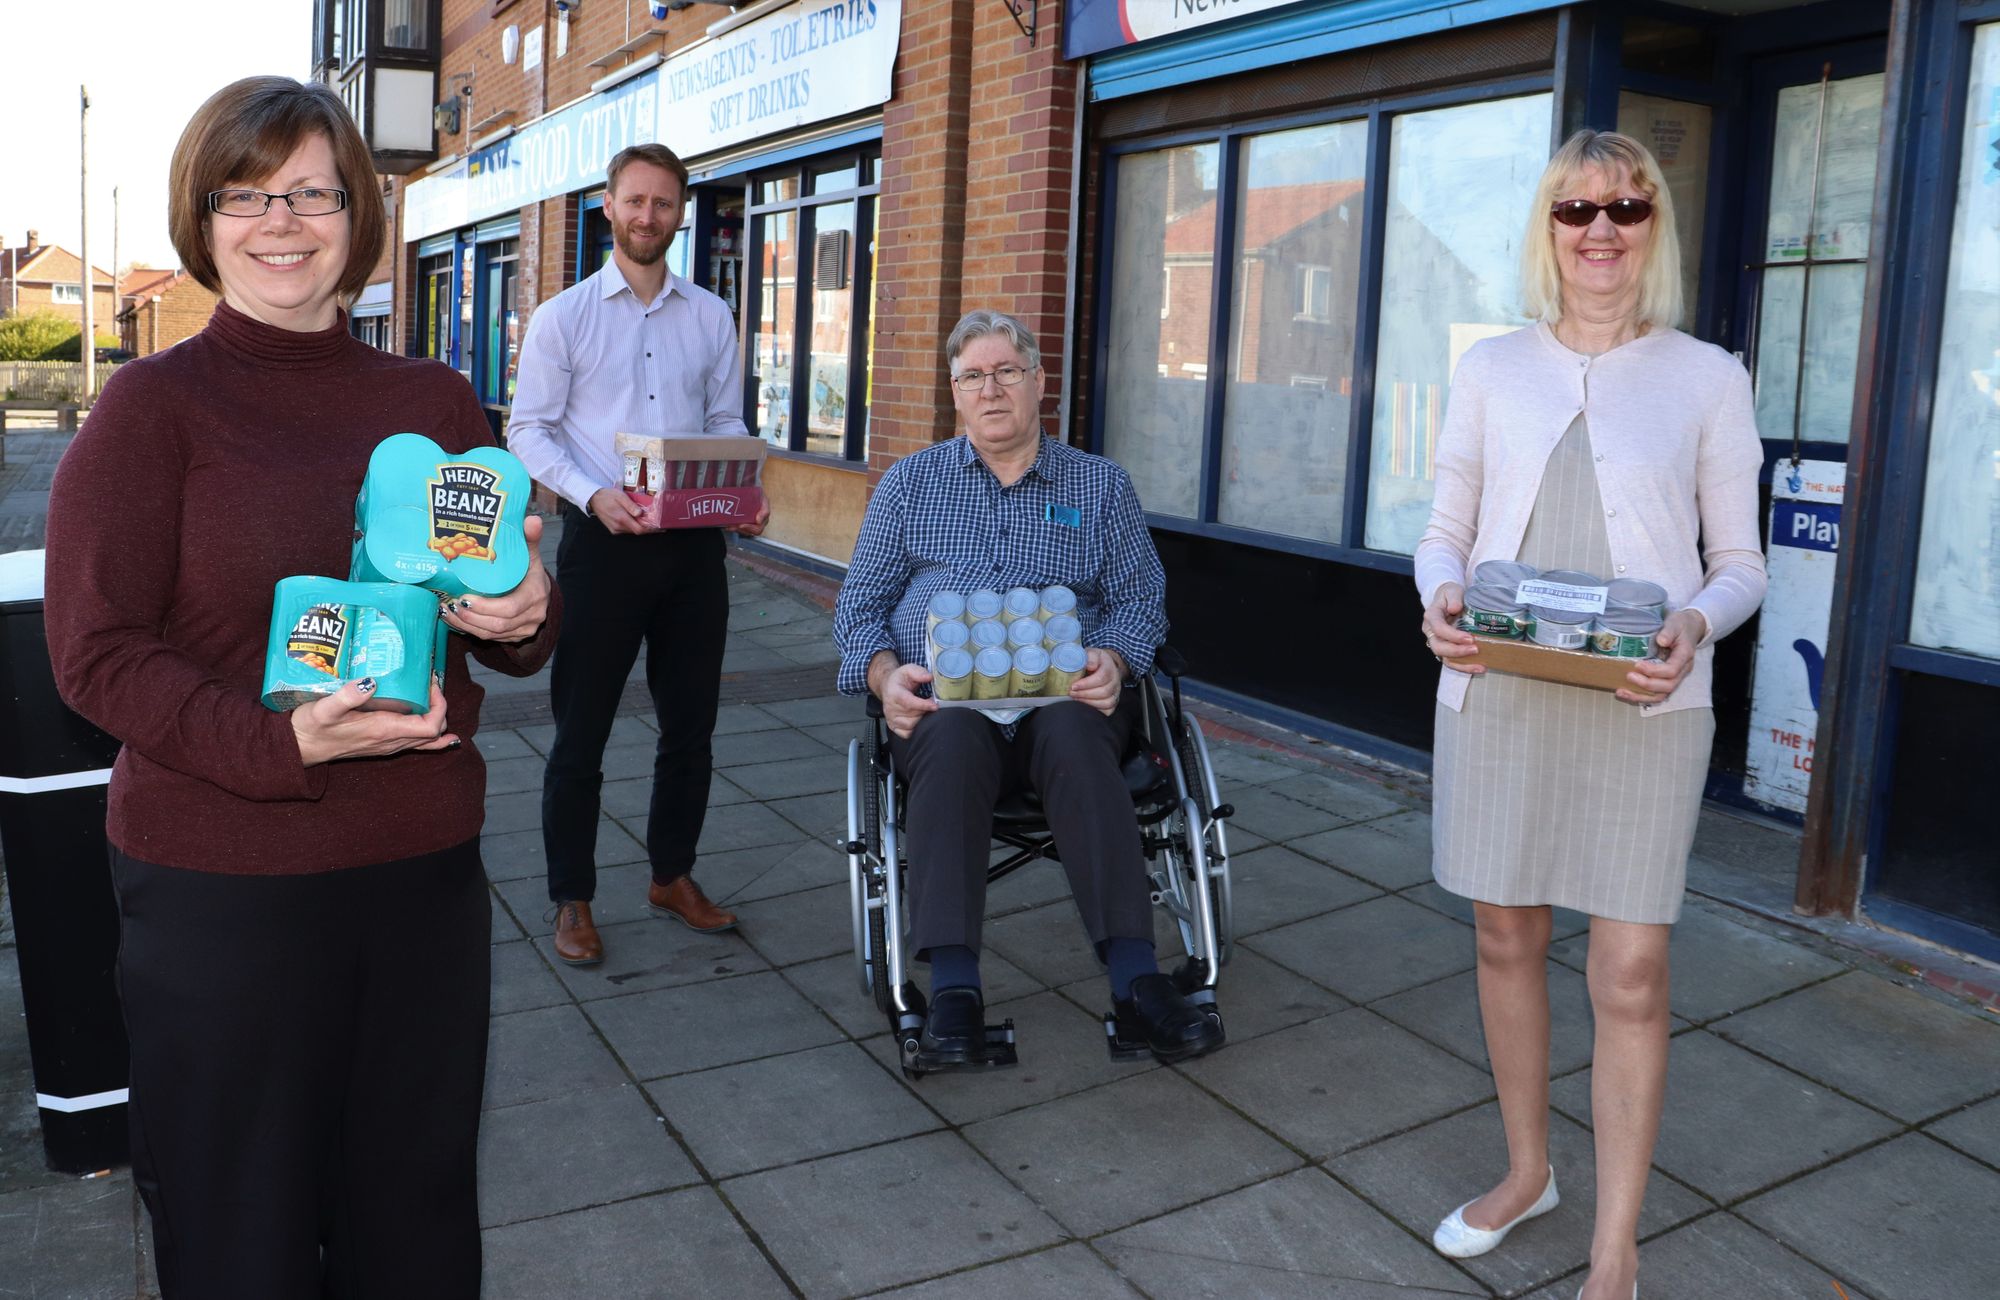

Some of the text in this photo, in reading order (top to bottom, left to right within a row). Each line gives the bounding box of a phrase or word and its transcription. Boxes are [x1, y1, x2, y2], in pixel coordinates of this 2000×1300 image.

[1174, 0, 1240, 19] Ne
[669, 38, 757, 104] NEWSAGENTS
[770, 0, 878, 66] TOILETRIES
[709, 91, 744, 134] SOFT
[747, 68, 811, 122] DRINKS
[519, 123, 572, 196] FOOD
[577, 90, 636, 178] CITY
[445, 469, 493, 489] HEINZ
[1805, 482, 1824, 492] THE
[434, 488, 497, 516] BEANZ
[692, 499, 735, 517] HEINZ
[446, 509, 458, 517] rich
[458, 511, 478, 520] tomato
[292, 615, 342, 639] EANZ
[308, 634, 327, 642] tomato
[1771, 728, 1802, 749] THE
